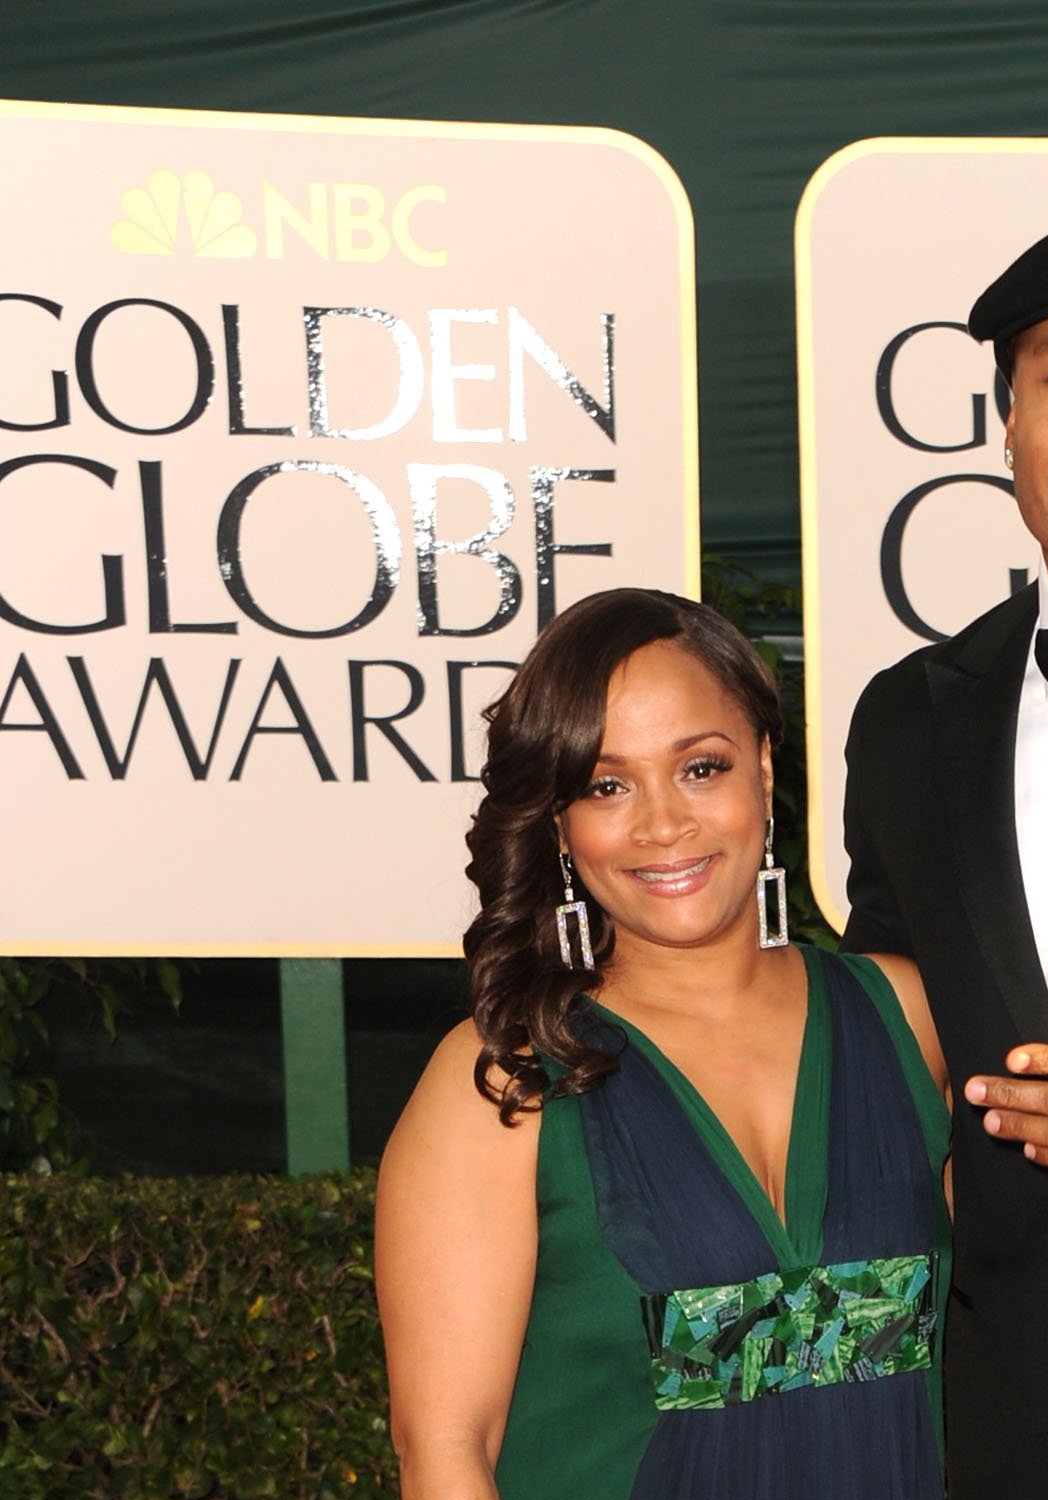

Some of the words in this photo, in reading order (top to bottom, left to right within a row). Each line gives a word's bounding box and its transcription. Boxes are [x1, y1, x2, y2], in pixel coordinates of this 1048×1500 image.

[265, 178, 448, 267] NBC
[0, 293, 616, 446] GOLDEN
[0, 453, 616, 640] GLOBE
[0, 652, 521, 783] AWARD
